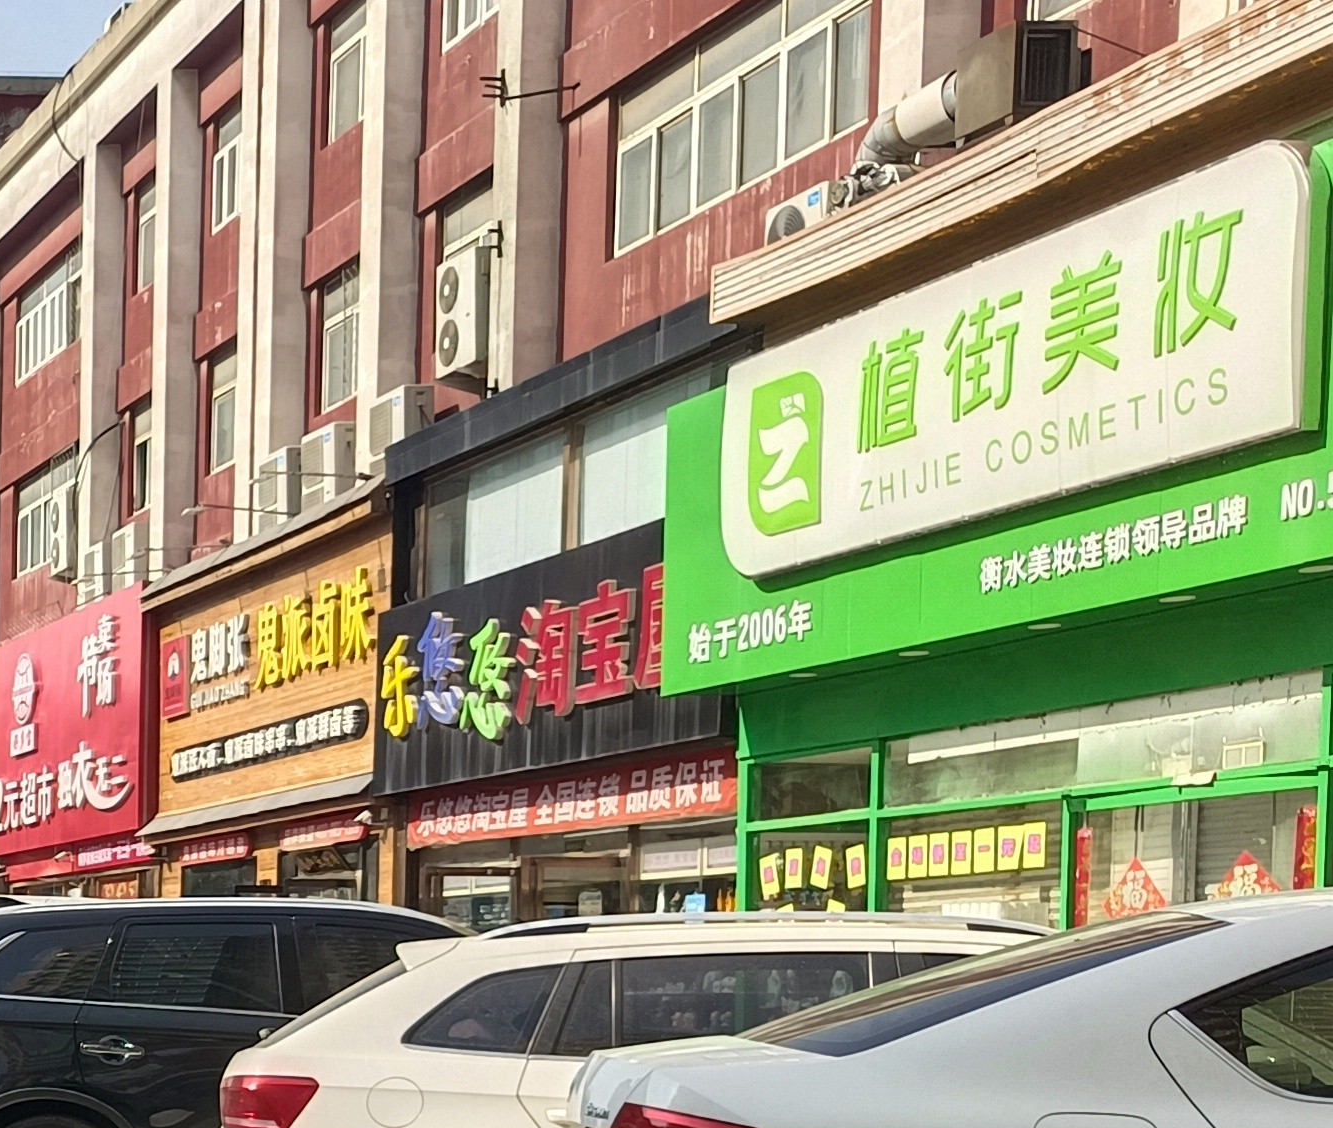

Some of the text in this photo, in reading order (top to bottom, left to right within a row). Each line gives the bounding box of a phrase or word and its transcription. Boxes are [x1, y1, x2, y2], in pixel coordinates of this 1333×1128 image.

[857, 208, 1244, 454] 植街美妆
[859, 367, 1231, 512] ZHIJIE COSMETICS
[979, 471, 1333, 594] 衡水美妆连锁领导品牌 NO.
[190, 567, 377, 690] 鬼脚张 鬼派卤味
[687, 600, 813, 664] 始于2006年
[533, 772, 620, 826] 全国连锁
[625, 758, 726, 814] 品质保证
[1121, 869, 1148, 911] 福
